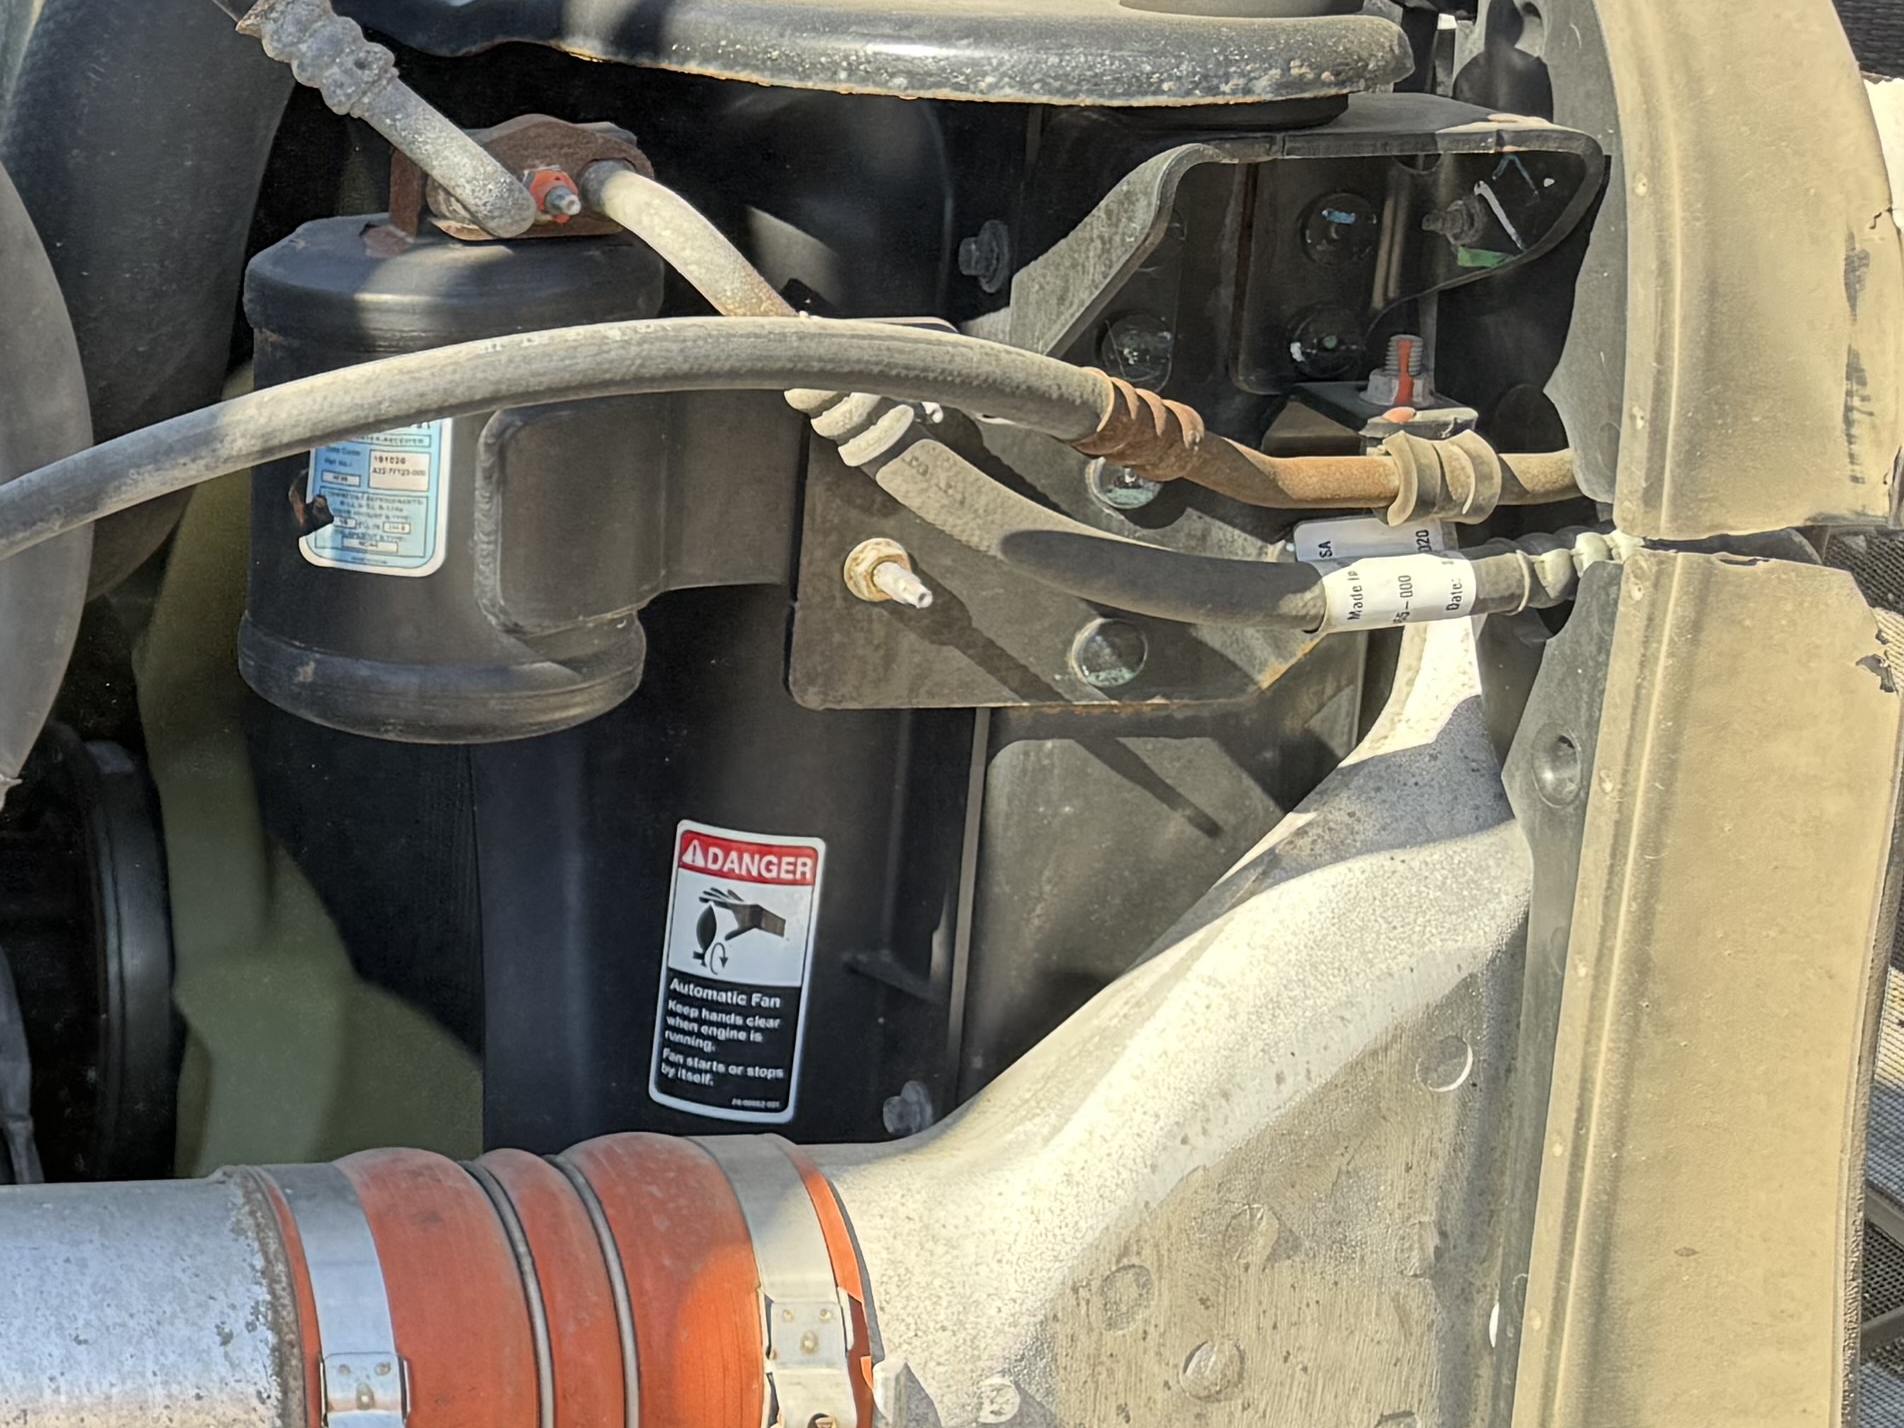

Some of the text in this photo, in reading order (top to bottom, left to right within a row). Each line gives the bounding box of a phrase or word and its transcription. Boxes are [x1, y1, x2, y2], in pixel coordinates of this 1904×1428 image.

[1347, 585, 1363, 621] Made
[707, 847, 813, 880] DANGER
[670, 978, 781, 1009] Automatic Fan
[666, 1015, 763, 1043] when engine is
[668, 999, 781, 1029] Keep hands clear
[661, 1062, 676, 1079] by
[663, 1047, 785, 1080] Fan starts or stops
